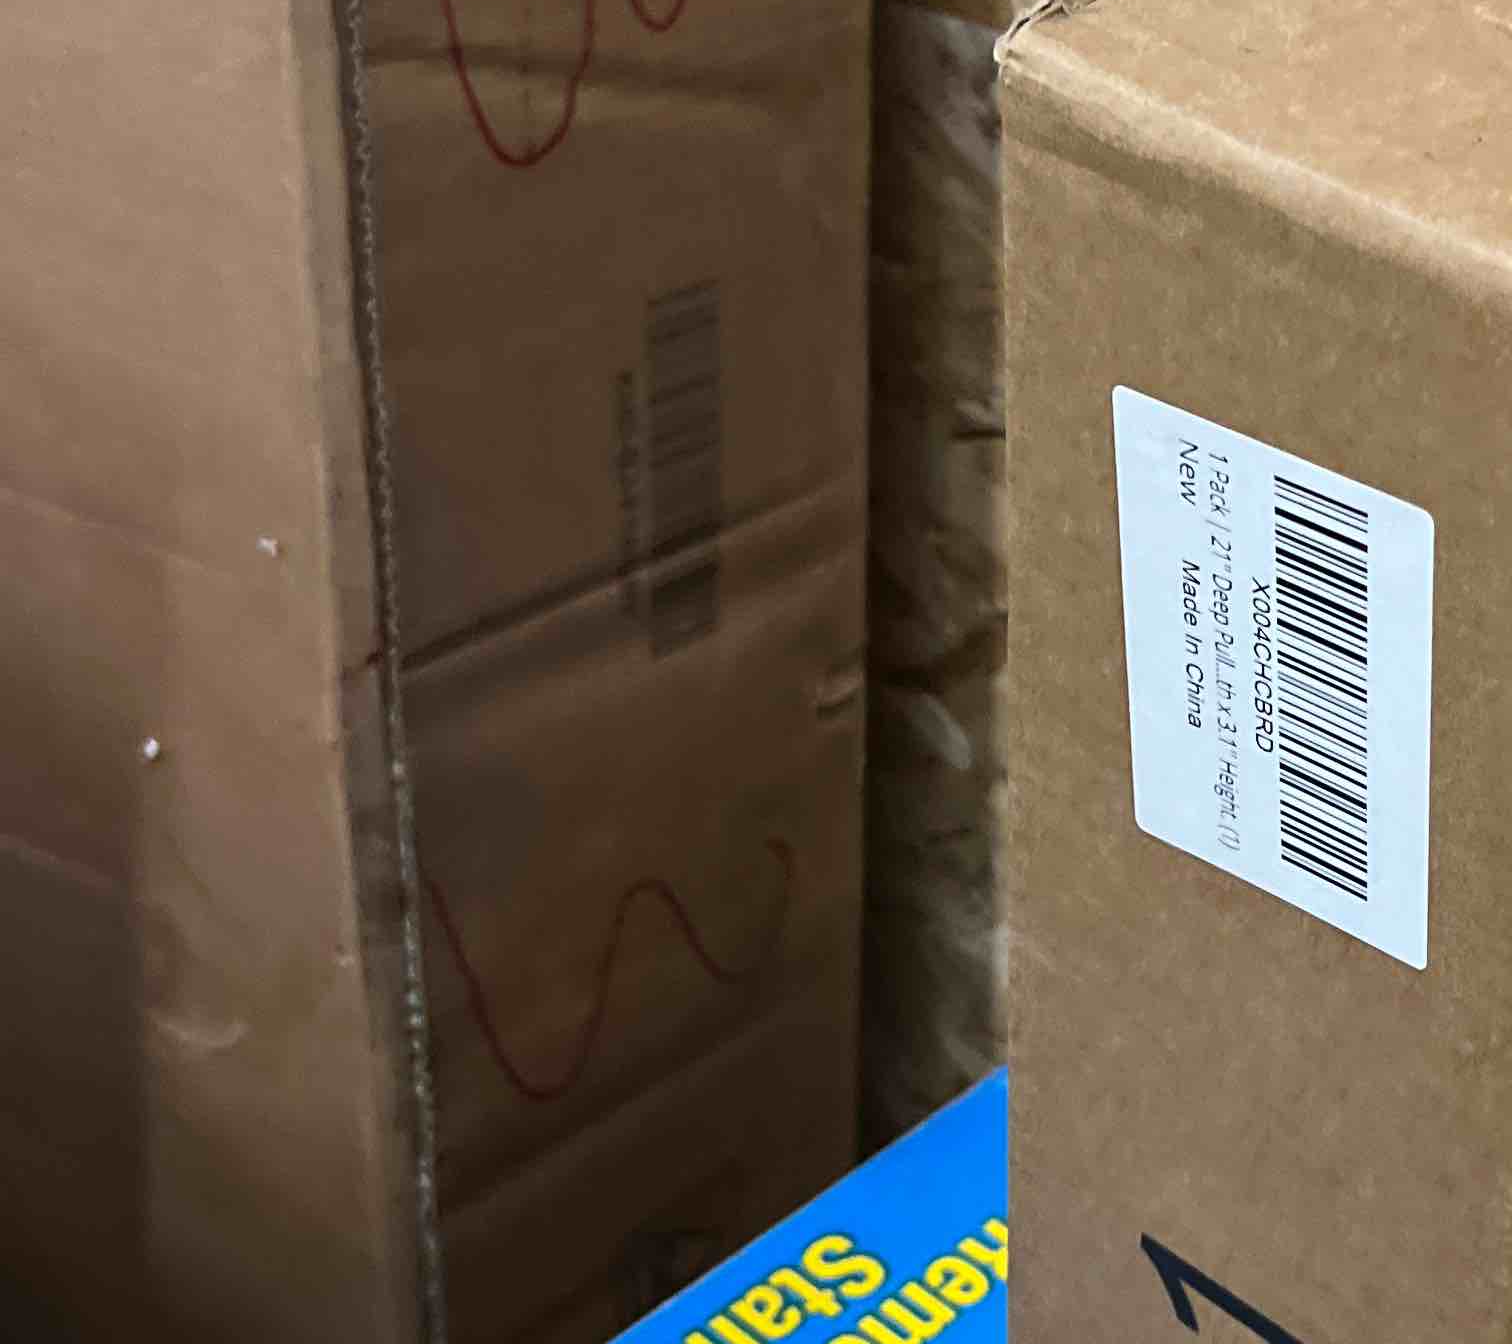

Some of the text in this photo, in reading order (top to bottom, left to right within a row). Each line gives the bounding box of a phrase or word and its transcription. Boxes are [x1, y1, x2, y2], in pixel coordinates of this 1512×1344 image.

[1177, 438, 1199, 506] New
[1208, 453, 1229, 464] 1
[1208, 469, 1231, 517] Pack
[1209, 573, 1233, 625] Deep
[1181, 559, 1204, 729] Made In China
[1252, 577, 1274, 753] X004CHCBRD
[1217, 704, 1233, 715] x
